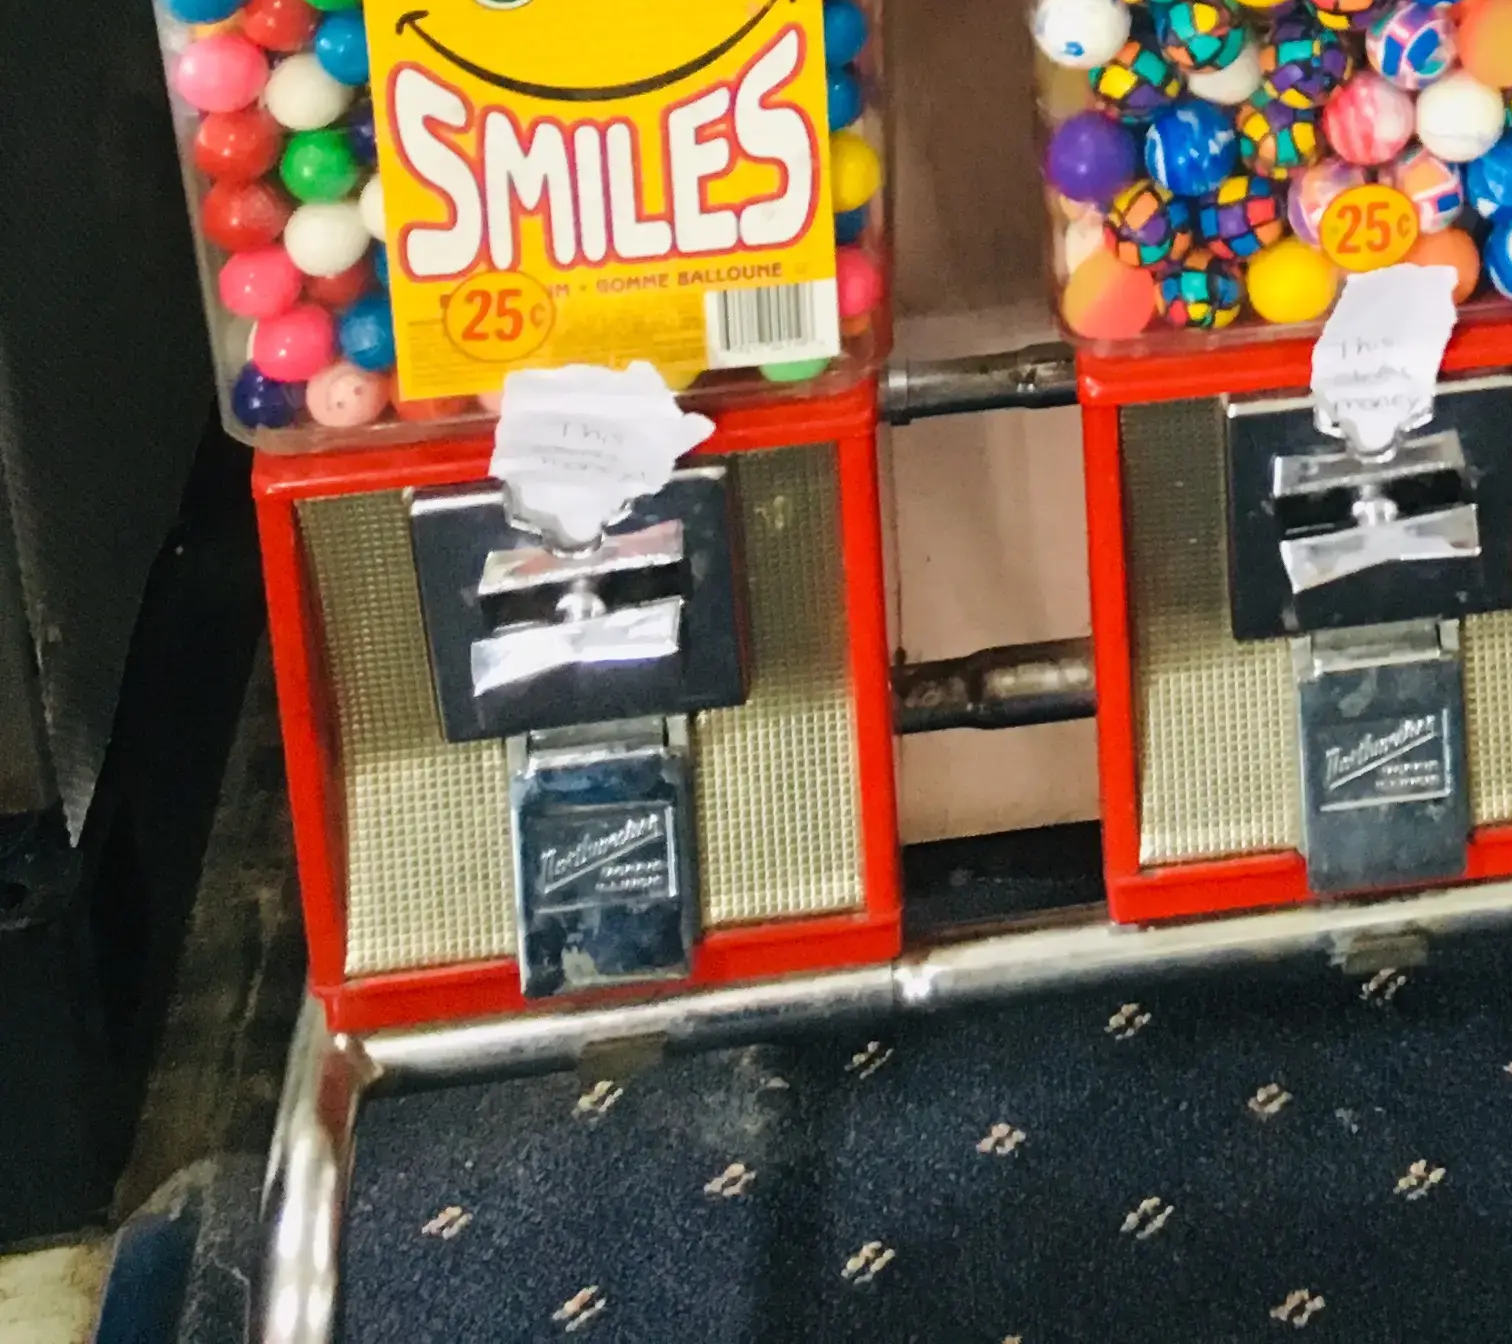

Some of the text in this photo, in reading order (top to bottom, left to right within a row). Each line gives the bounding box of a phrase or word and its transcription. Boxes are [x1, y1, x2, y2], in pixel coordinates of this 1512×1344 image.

[387, 22, 820, 282] SMILES
[1336, 201, 1411, 254] 25¢
[596, 273, 669, 293] GOMME
[678, 262, 782, 287] BALLOUNE
[461, 288, 546, 342] 25¢
